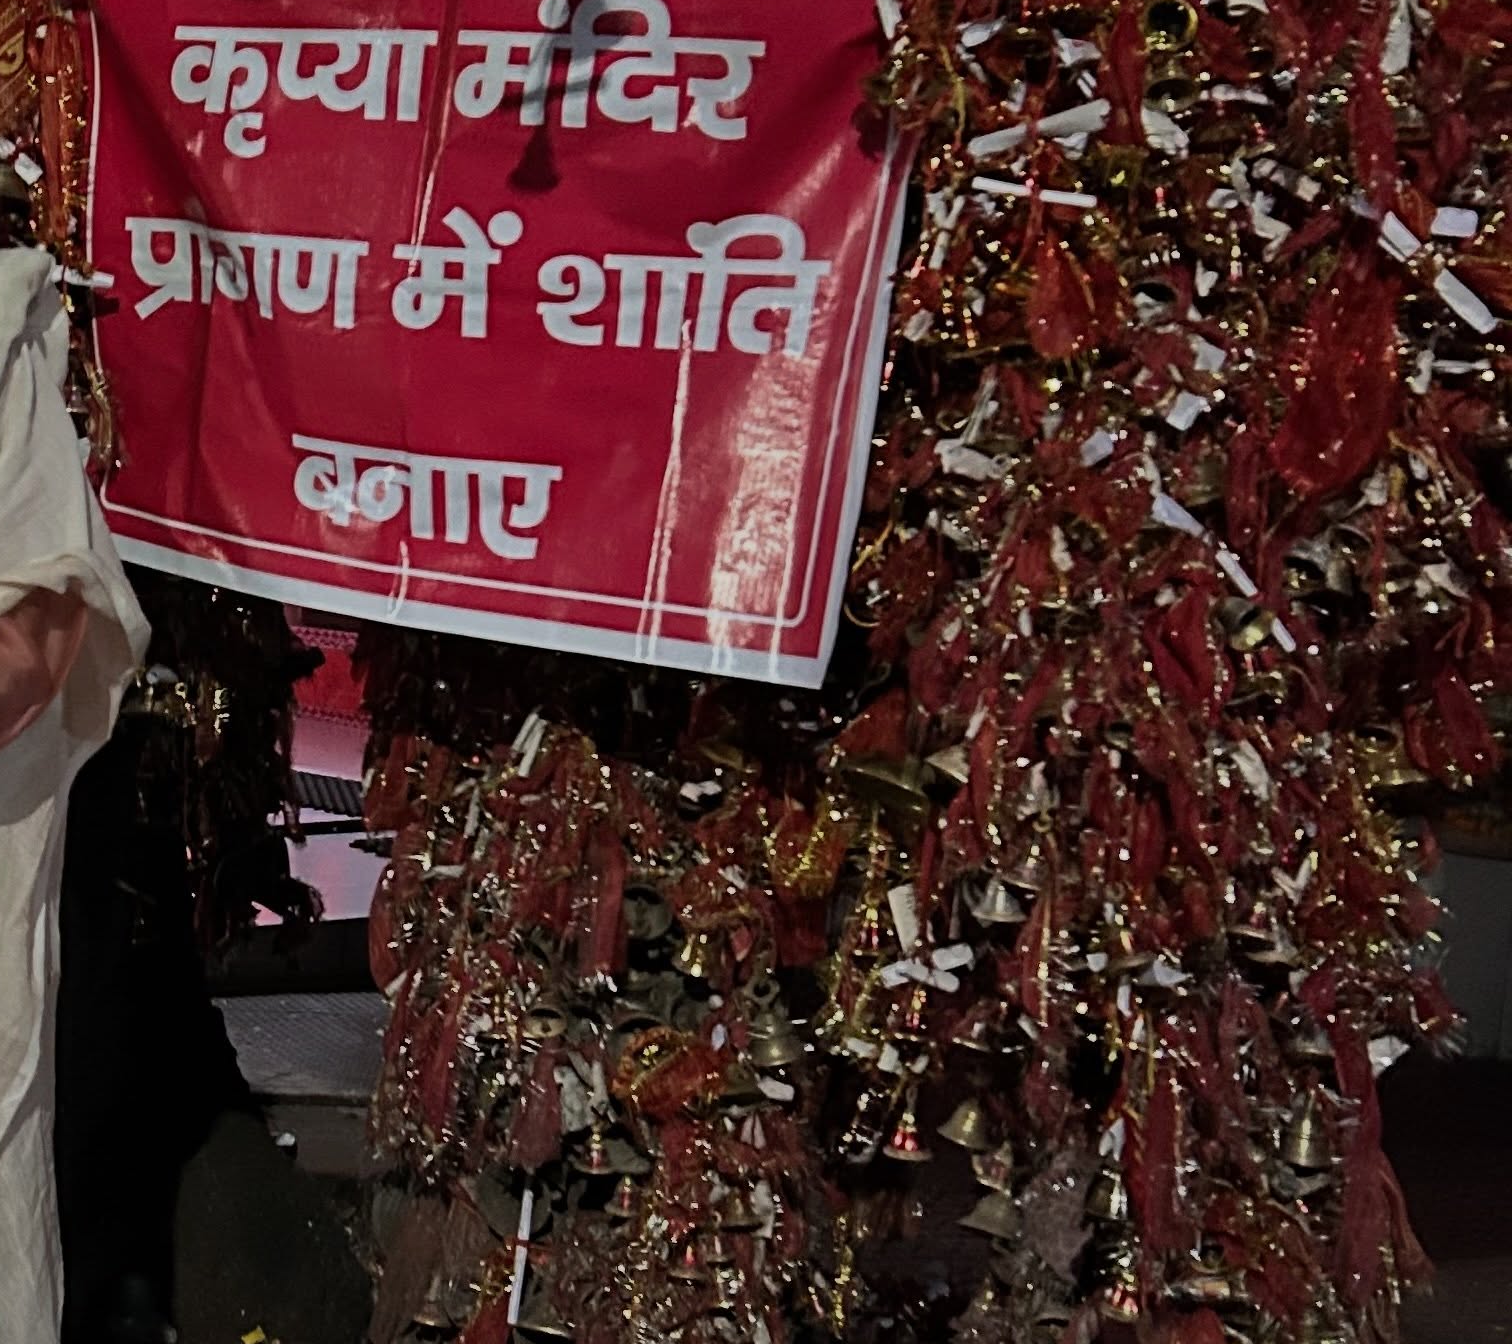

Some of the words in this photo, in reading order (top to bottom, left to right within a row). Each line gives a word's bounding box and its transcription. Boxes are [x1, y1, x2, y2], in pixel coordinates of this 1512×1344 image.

[171, 24, 438, 159] कृप्या
[391, 206, 524, 338] में
[291, 433, 564, 560] बनाए
